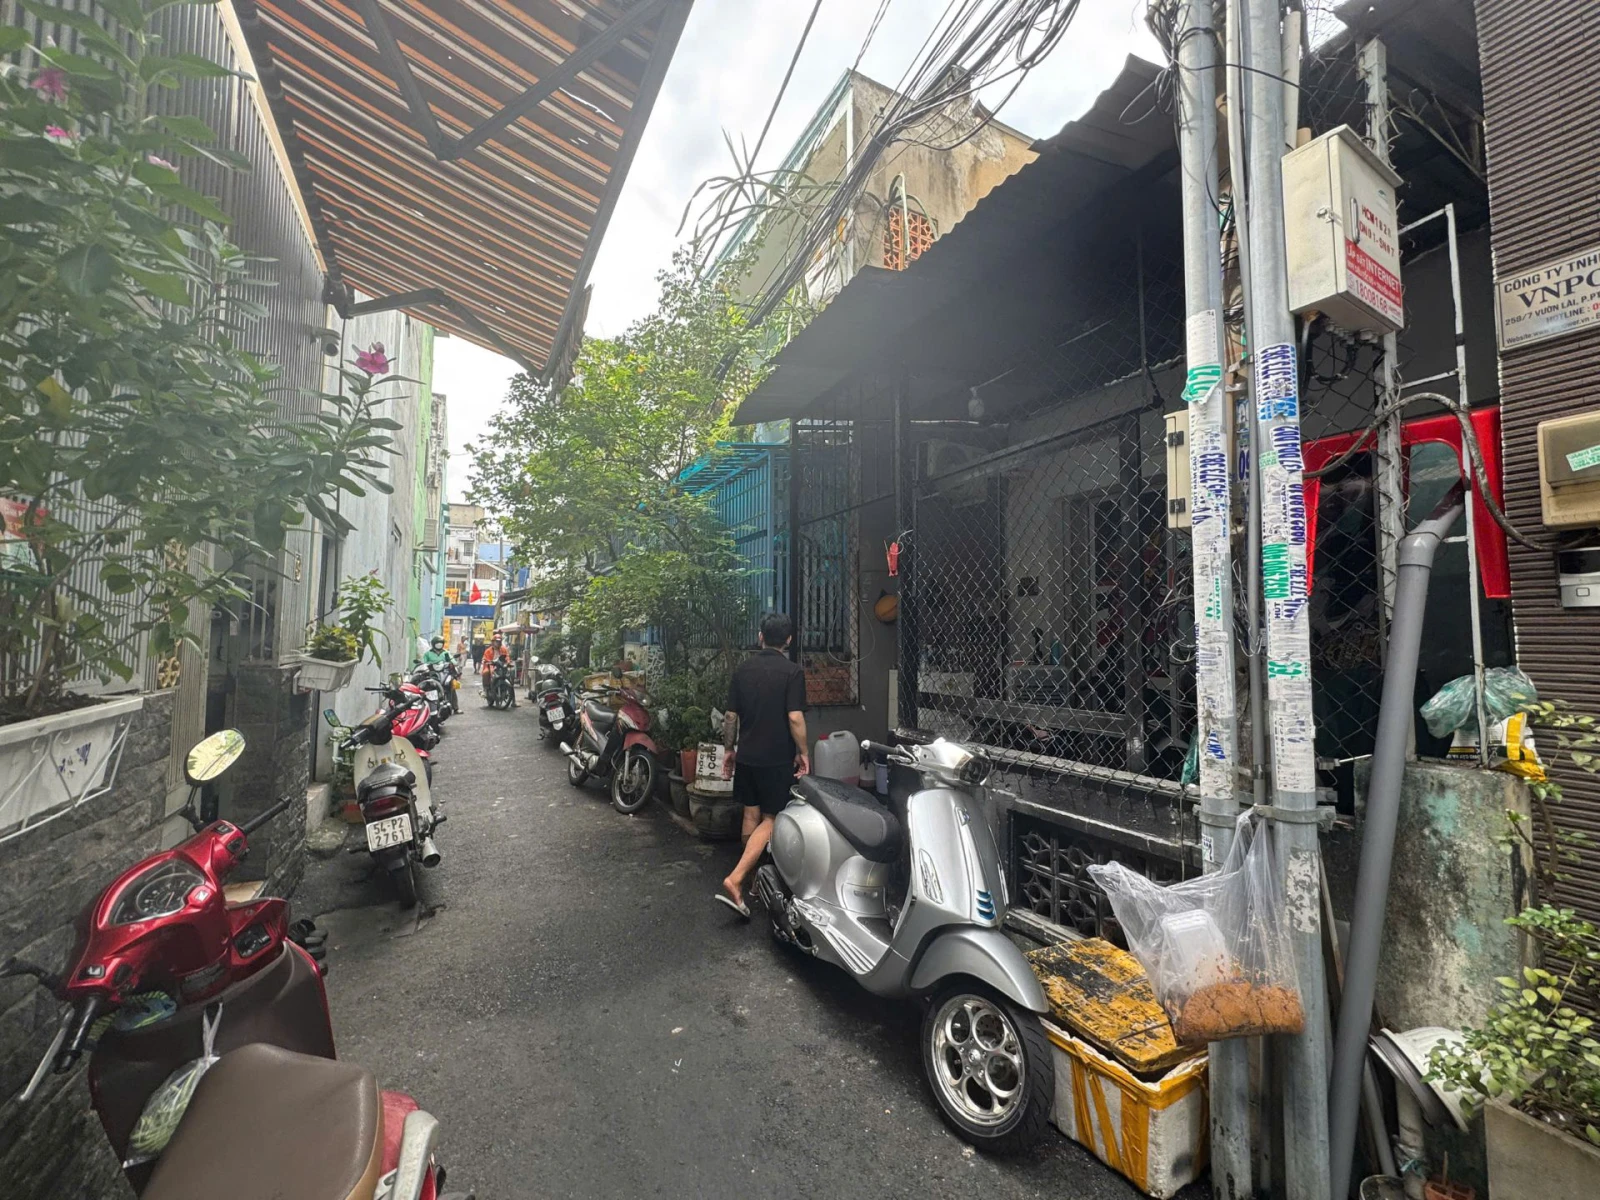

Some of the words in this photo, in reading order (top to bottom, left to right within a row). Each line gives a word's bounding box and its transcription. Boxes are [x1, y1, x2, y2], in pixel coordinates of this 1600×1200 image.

[1365, 257, 1400, 294] INTERNET
[1504, 274, 1541, 294] CÔNG
[1544, 265, 1563, 280] TY
[1566, 253, 1600, 272] TNH
[373, 817, 404, 836] 54-P2
[375, 830, 406, 847] 2761
